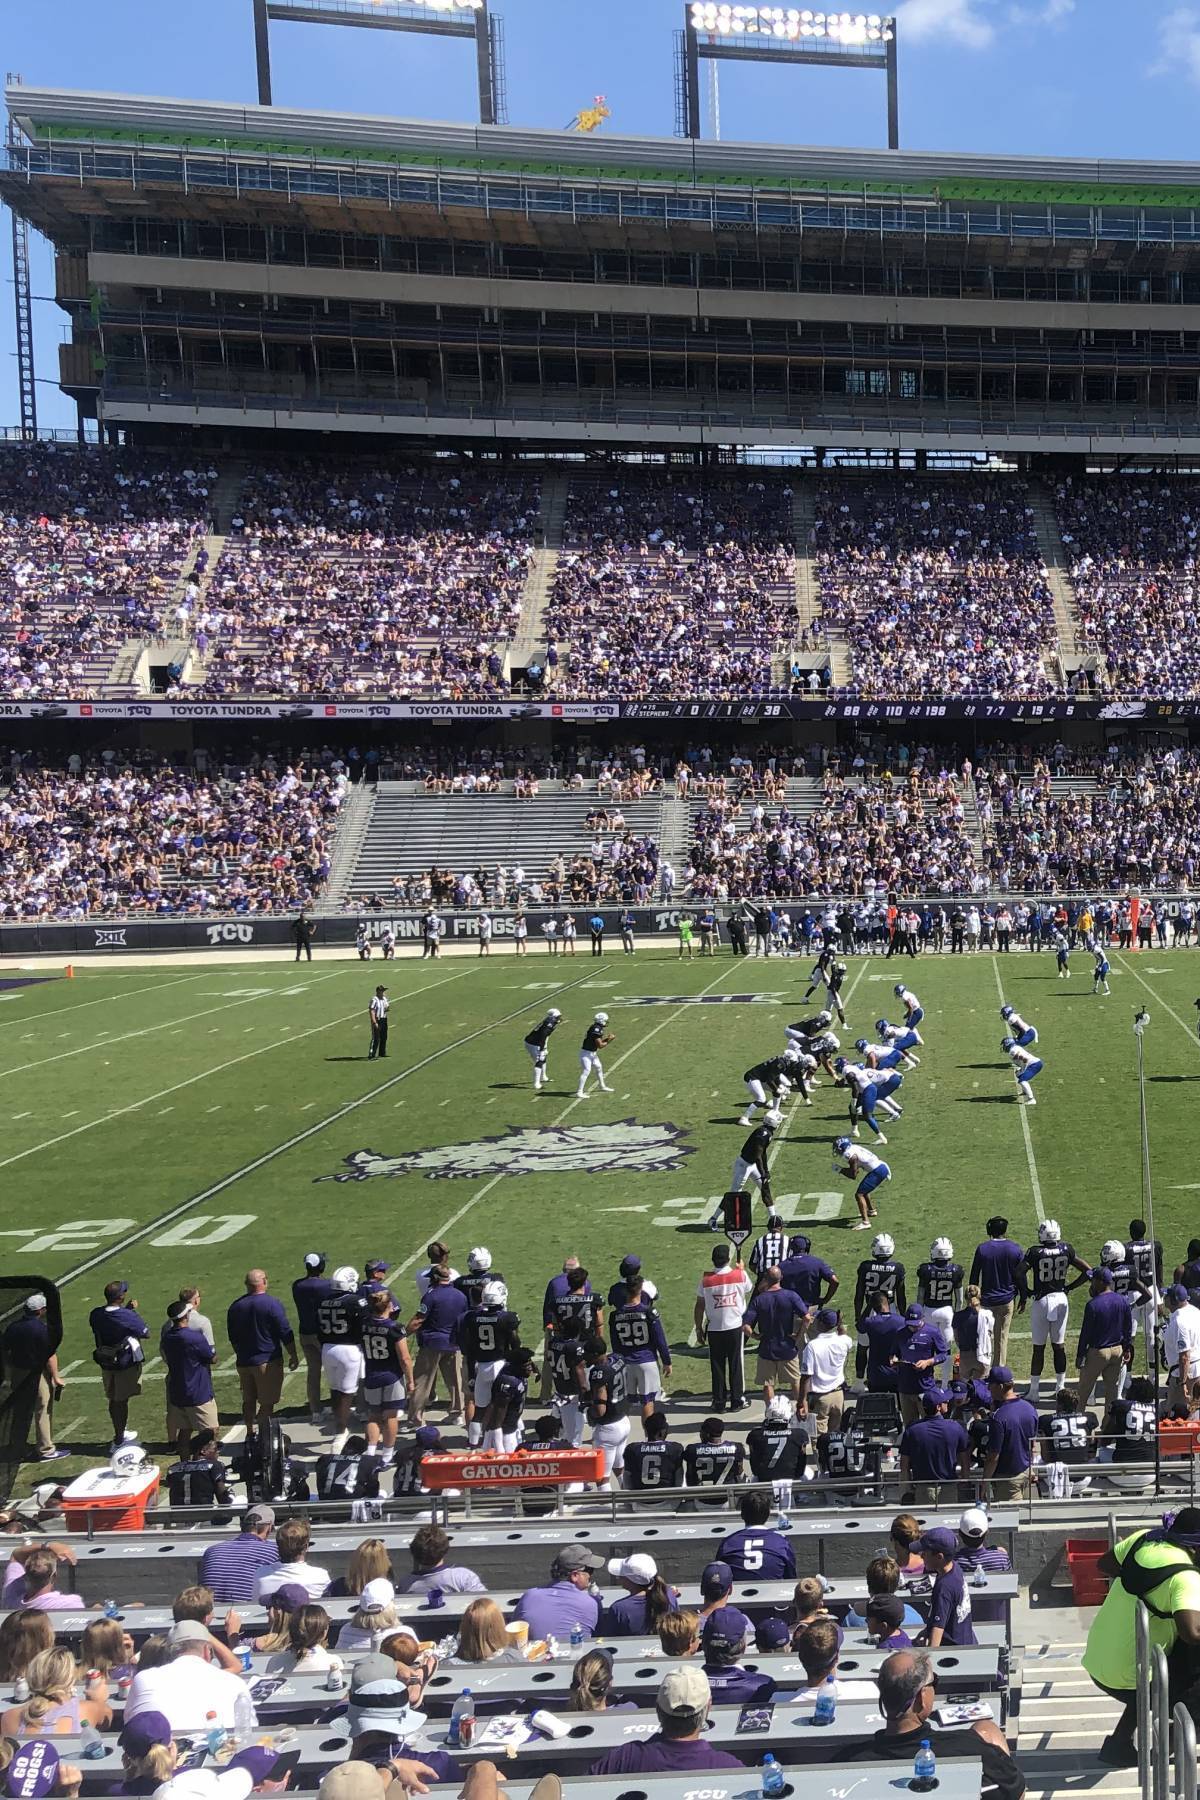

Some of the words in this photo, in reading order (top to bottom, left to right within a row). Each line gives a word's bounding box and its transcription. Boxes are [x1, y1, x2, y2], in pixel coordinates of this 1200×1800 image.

[127, 706, 152, 716] TCU
[170, 705, 218, 716] TOYOTA
[222, 705, 272, 716] TUNDRA
[368, 705, 391, 716] TCU
[408, 705, 453, 716] TOYOTA
[456, 705, 503, 716] TUNDRA
[592, 705, 614, 716] TCU
[764, 705, 781, 716] 38
[844, 705, 860, 716] 88
[885, 705, 903, 716] 110
[925, 705, 946, 716] 198
[1031, 705, 1044, 716] 19
[1158, 706, 1173, 715] 28
[207, 923, 253, 945] TCU
[453, 917, 516, 936] FRGS
[730, 1231, 745, 1239] TCU
[765, 1239, 781, 1259] H
[1039, 1255, 1069, 1283] 88
[865, 1271, 897, 1295] 24
[929, 1280, 954, 1301] 12
[318, 1308, 348, 1335] 55
[478, 1324, 496, 1351] 9
[615, 1320, 650, 1347] 29
[362, 1334, 390, 1360] 18
[1050, 1415, 1087, 1449] 25
[767, 1436, 788, 1469] 7
[324, 1461, 360, 1494] 14
[461, 1461, 560, 1481] GATORADE
[641, 1455, 661, 1486] 6
[696, 1456, 736, 1487] 27
[181, 1473, 192, 1505] 1
[743, 1539, 765, 1570] 5
[623, 1723, 661, 1734] TCU
[13, 1756, 29, 1779] GO
[21, 1742, 47, 1797] FROGS!
[683, 1789, 728, 1800] TCU
